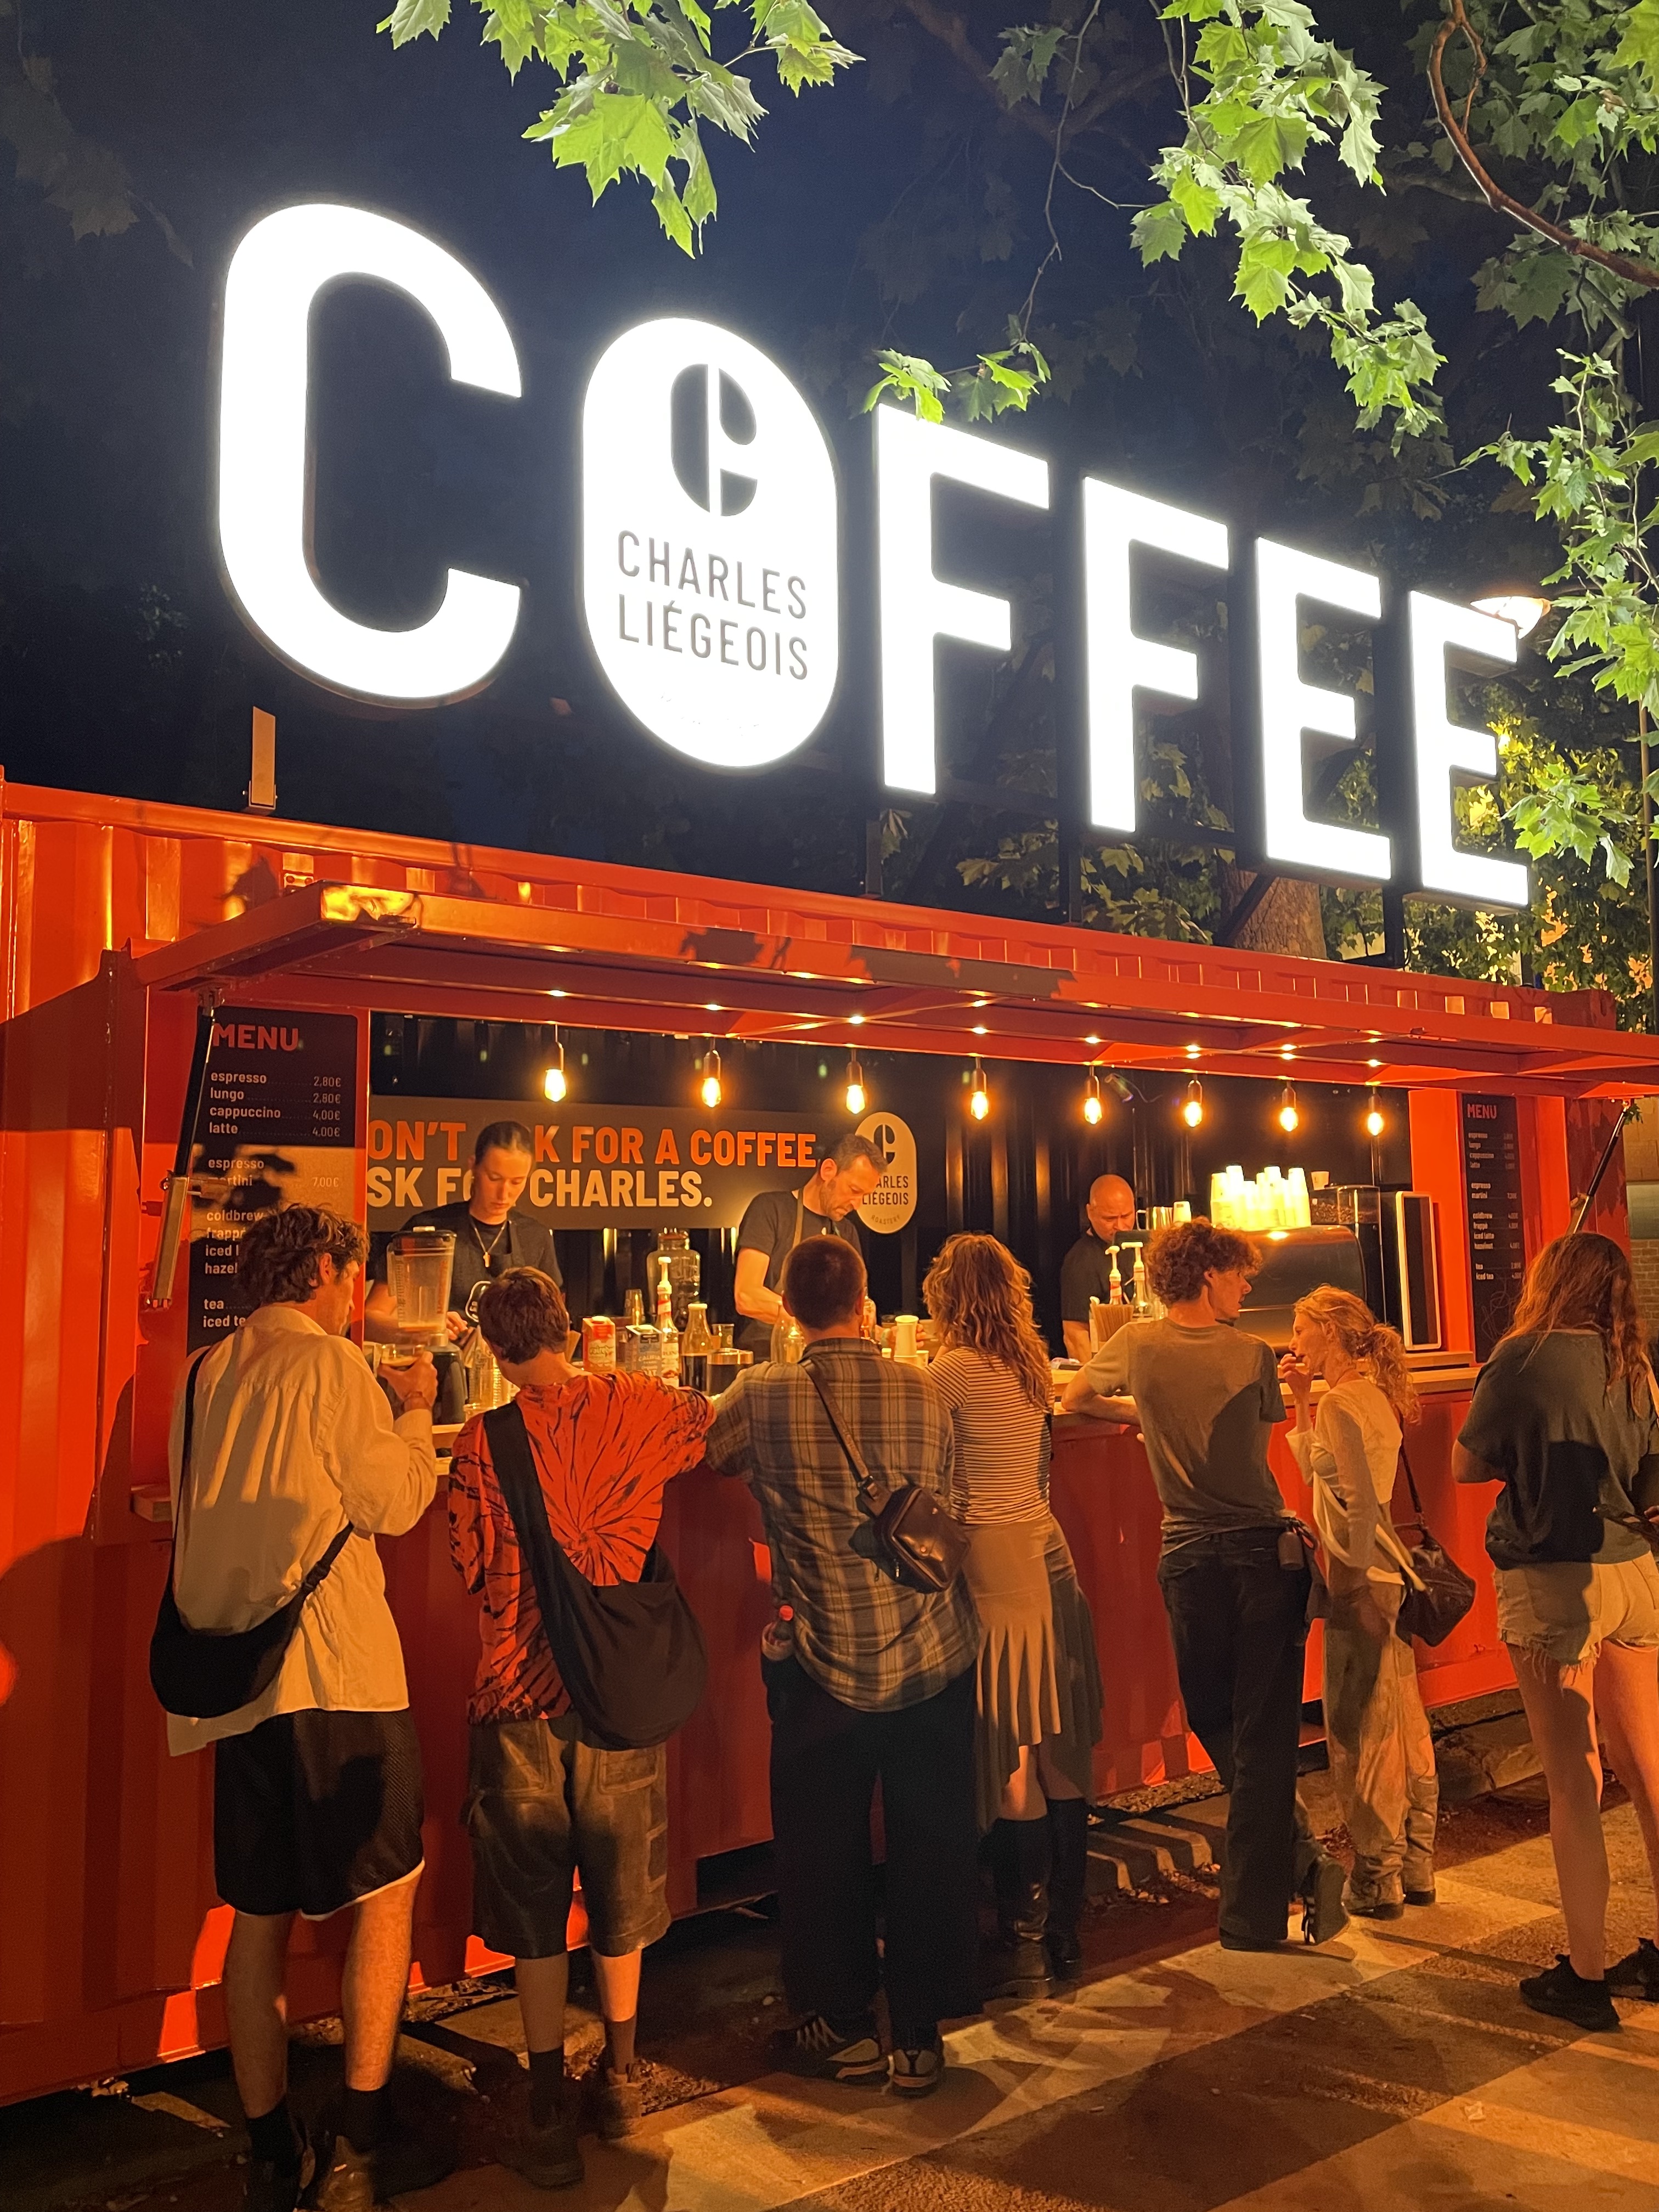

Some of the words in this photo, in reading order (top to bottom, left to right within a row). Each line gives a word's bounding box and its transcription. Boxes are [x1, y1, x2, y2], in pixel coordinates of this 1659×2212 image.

[618, 529, 807, 619] CHARLES
[619, 593, 808, 680] LIÉGEOIS
[213, 1023, 298, 1051] MENU
[211, 1072, 267, 1084] espresso
[210, 1087, 245, 1102] lungo
[210, 1106, 281, 1119] cappuccino
[1467, 1104, 1497, 1119] MENU
[209, 1121, 238, 1135] latte
[368, 1120, 466, 1161] ON'T
[573, 1125, 644, 1164] FOR
[655, 1128, 680, 1165] A
[690, 1129, 816, 1167] COFFEE
[208, 1159, 264, 1171] espresso
[207, 1174, 253, 1186] rtini
[366, 1166, 424, 1207] SK
[529, 1168, 713, 1207] CHARLES.
[876, 1175, 909, 1188] ARLES
[862, 1190, 909, 1205] LIÉGEOIS
[206, 1209, 264, 1222] coldbrew
[205, 1244, 232, 1256] iced
[204, 1298, 224, 1310] tea
[202, 1314, 230, 1328] iced
[234, 1315, 246, 1327] te
